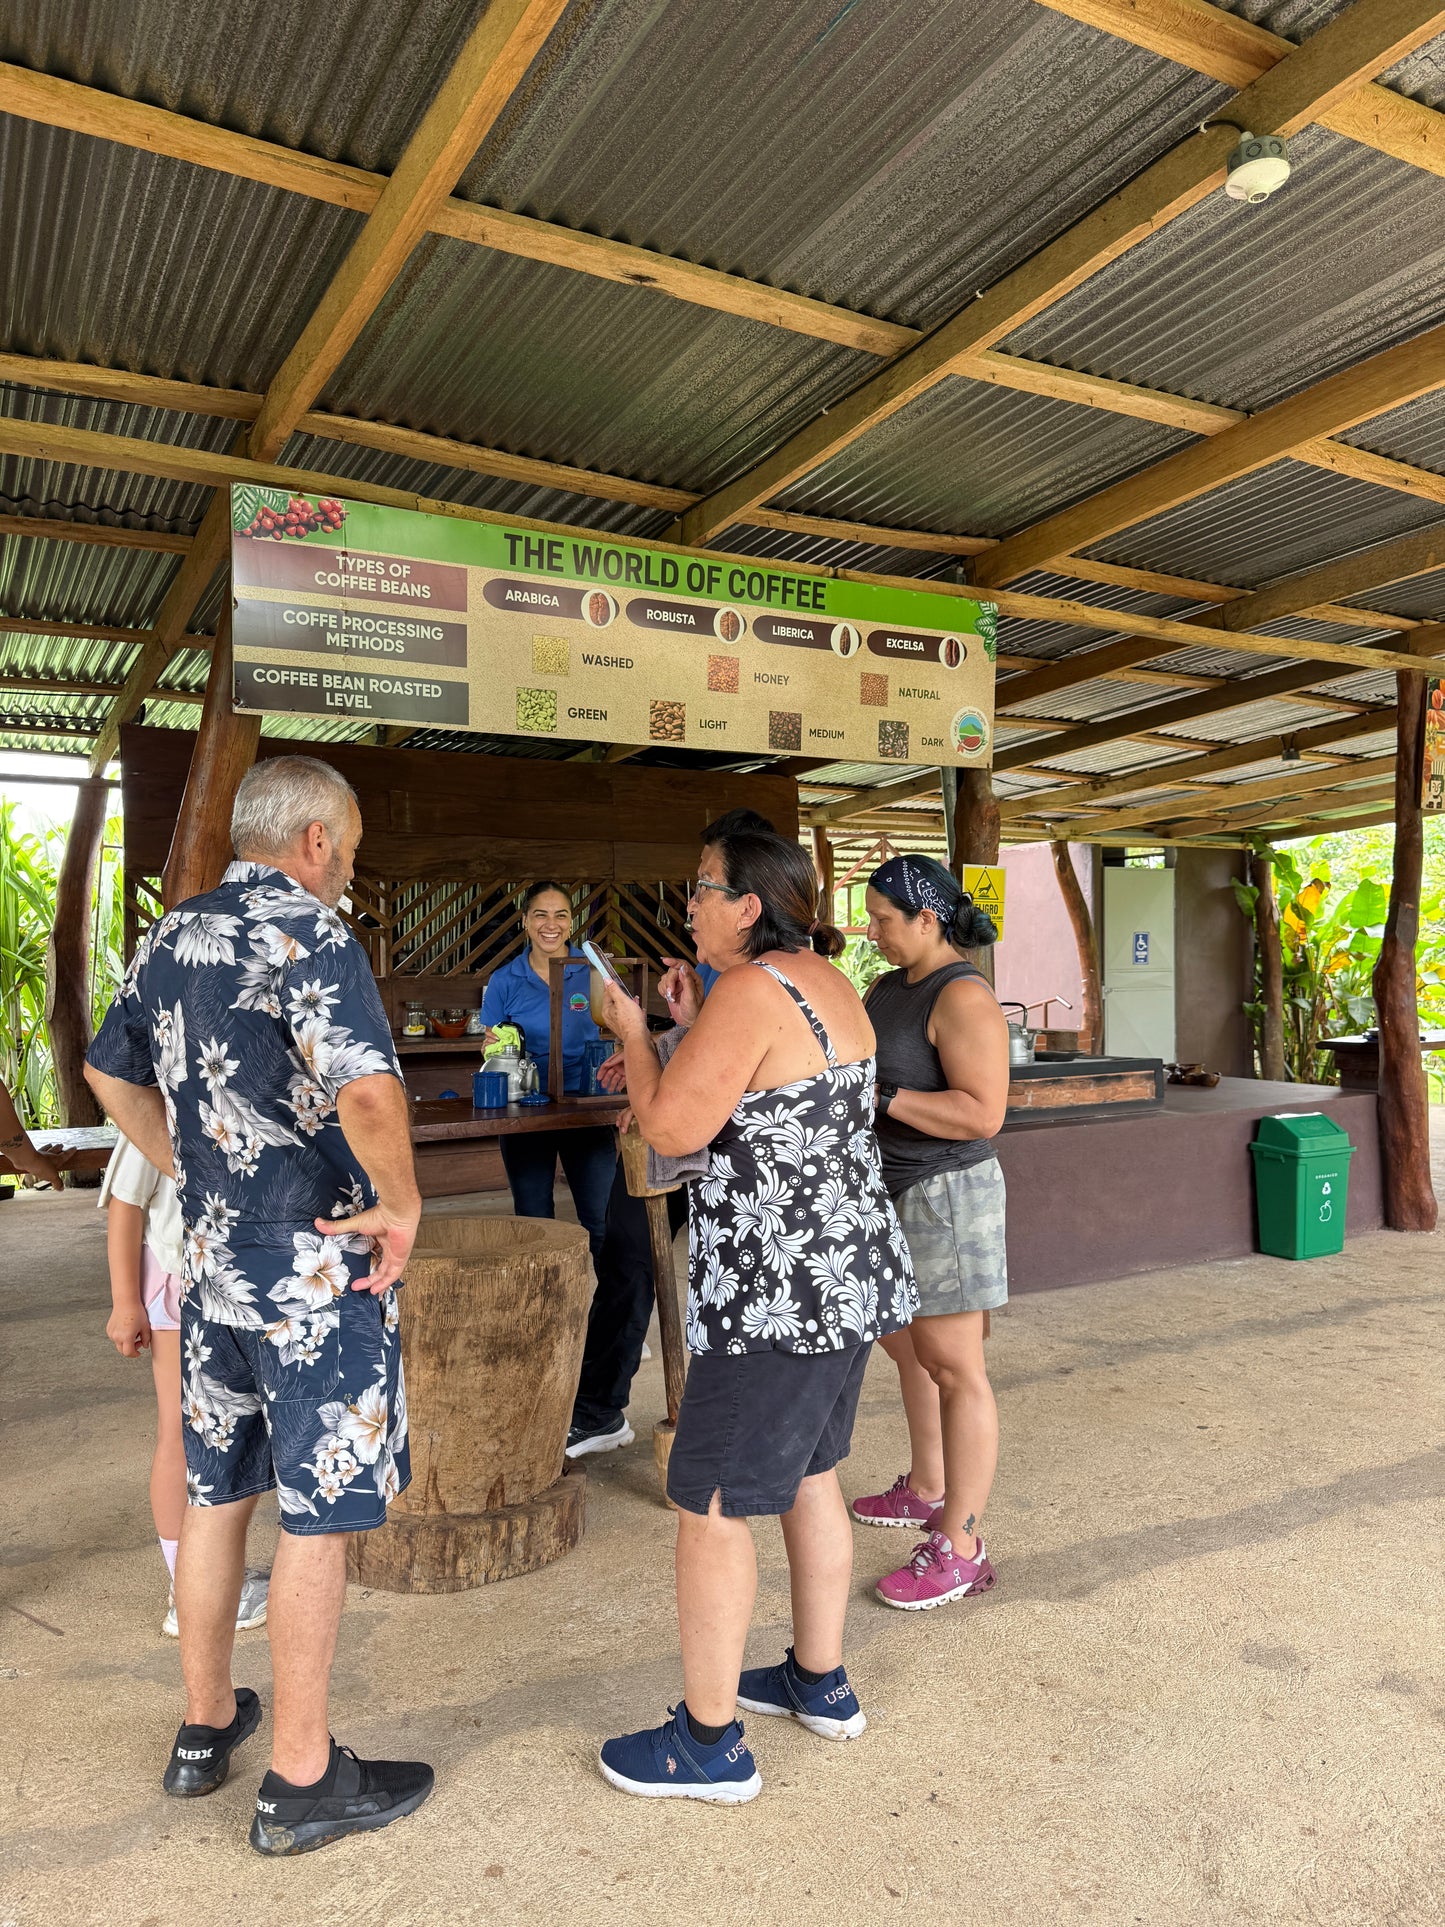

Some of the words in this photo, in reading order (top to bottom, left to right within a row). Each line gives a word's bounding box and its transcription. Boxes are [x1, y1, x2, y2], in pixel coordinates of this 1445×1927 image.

[336, 555, 385, 576] TYPES
[389, 562, 411, 578] OF
[504, 533, 564, 572] THE
[572, 544, 679, 587] WORLD
[686, 562, 723, 594] OF
[728, 569, 826, 610] COFFEE
[314, 571, 376, 591] COFFEE
[380, 580, 431, 599] BEANS
[646, 608, 695, 625] ROBUSTA
[282, 609, 338, 629] COFFE
[341, 616, 443, 641] PROCESSING
[772, 624, 814, 640] LIBERICA
[326, 634, 404, 654] METHODS
[886, 638, 924, 651] EXCELSA
[581, 652, 633, 669] WASHED
[252, 667, 318, 686] COFFEE
[322, 674, 363, 690] BEAN
[368, 679, 442, 698] ROASTED
[753, 671, 789, 686] HONEY
[325, 691, 372, 709] LEVEL
[898, 687, 940, 700] NATURAL
[567, 706, 607, 721] GREEN
[699, 718, 727, 730] LIGHT
[809, 727, 844, 740] MEDIUM
[921, 736, 944, 747] DARK
[177, 1747, 214, 1760] RBX
[257, 1798, 277, 1814] BX
